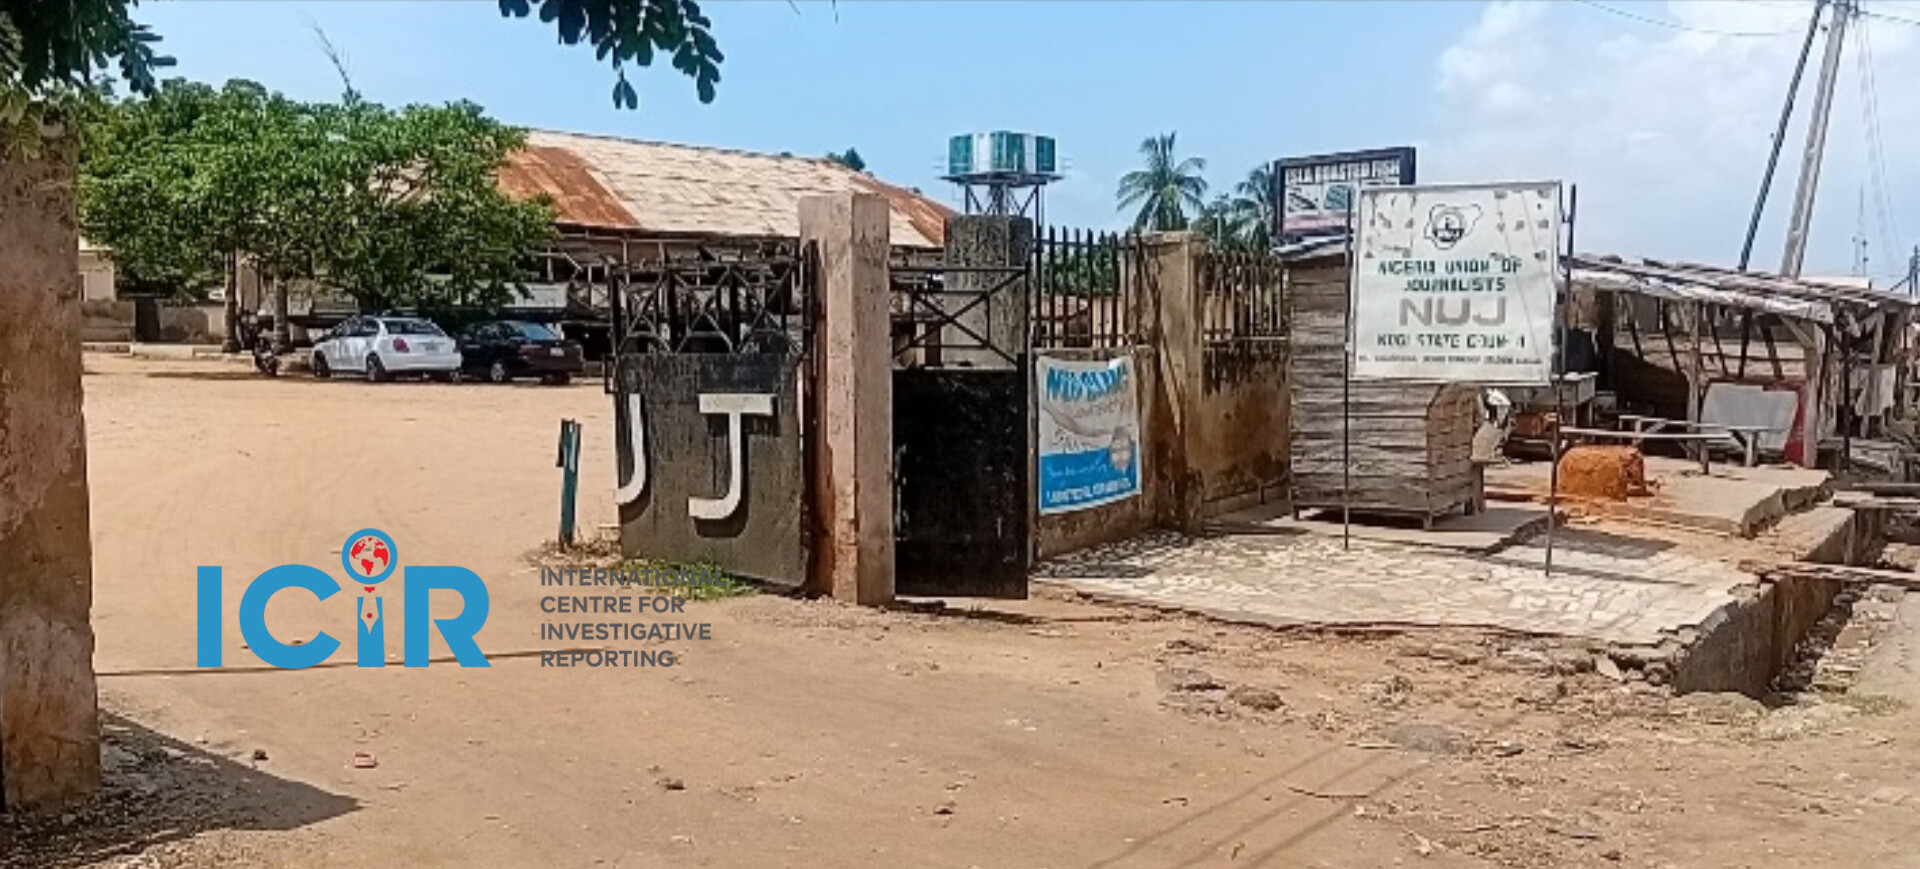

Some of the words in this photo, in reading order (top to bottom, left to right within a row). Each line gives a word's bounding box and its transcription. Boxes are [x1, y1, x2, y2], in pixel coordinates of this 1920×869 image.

[1372, 158, 1400, 177] FISH
[1445, 260, 1490, 275] UNION
[1502, 259, 1522, 274] OF
[1404, 277, 1506, 292] JOURNALISTS
[1400, 297, 1506, 327] NUJ
[1416, 334, 1460, 348] STATE
[1467, 334, 1525, 349] COUN
